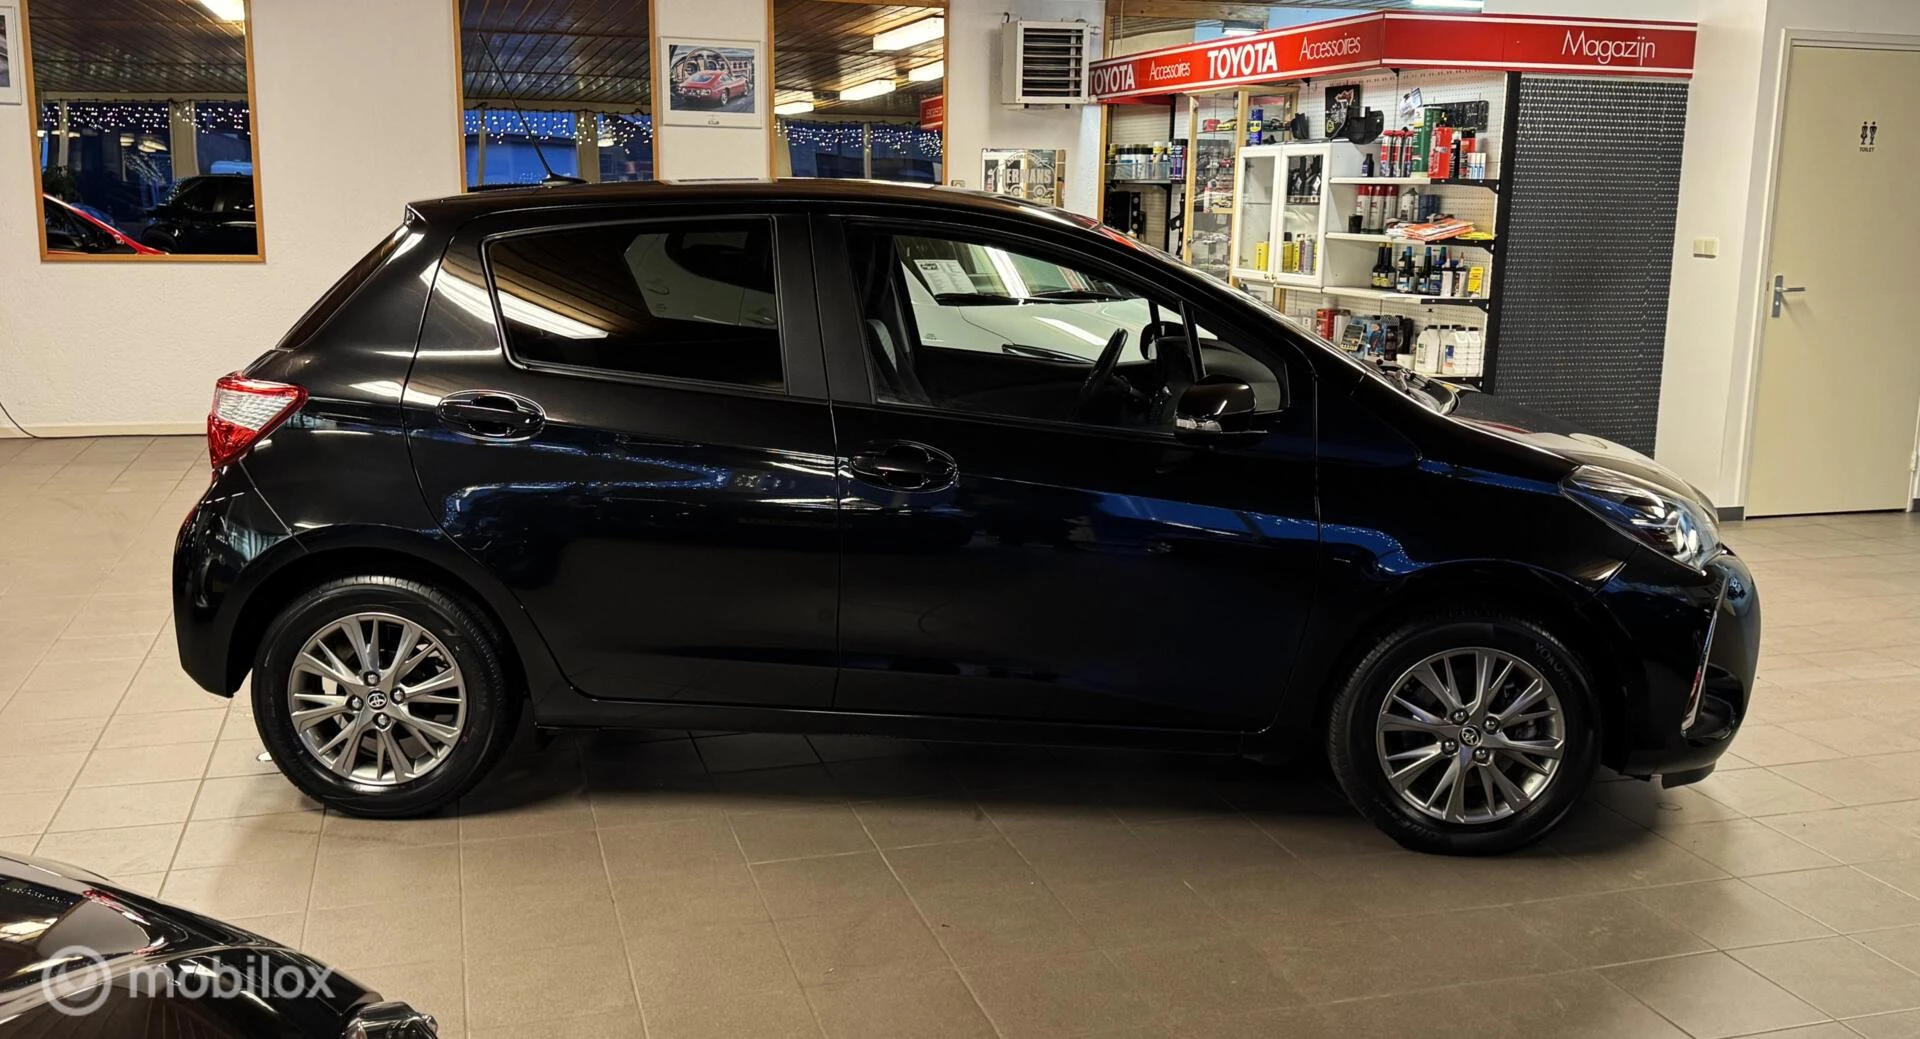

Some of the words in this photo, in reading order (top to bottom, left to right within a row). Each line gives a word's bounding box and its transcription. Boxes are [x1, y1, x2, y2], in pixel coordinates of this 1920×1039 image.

[1089, 64, 1136, 95] TOYOTA
[1149, 60, 1191, 81] Accessoires
[1207, 41, 1278, 79] TOYOTA
[1299, 34, 1361, 61] Accessoires
[1561, 30, 1656, 65] Magazijn
[997, 168, 1052, 184] HERMANS
